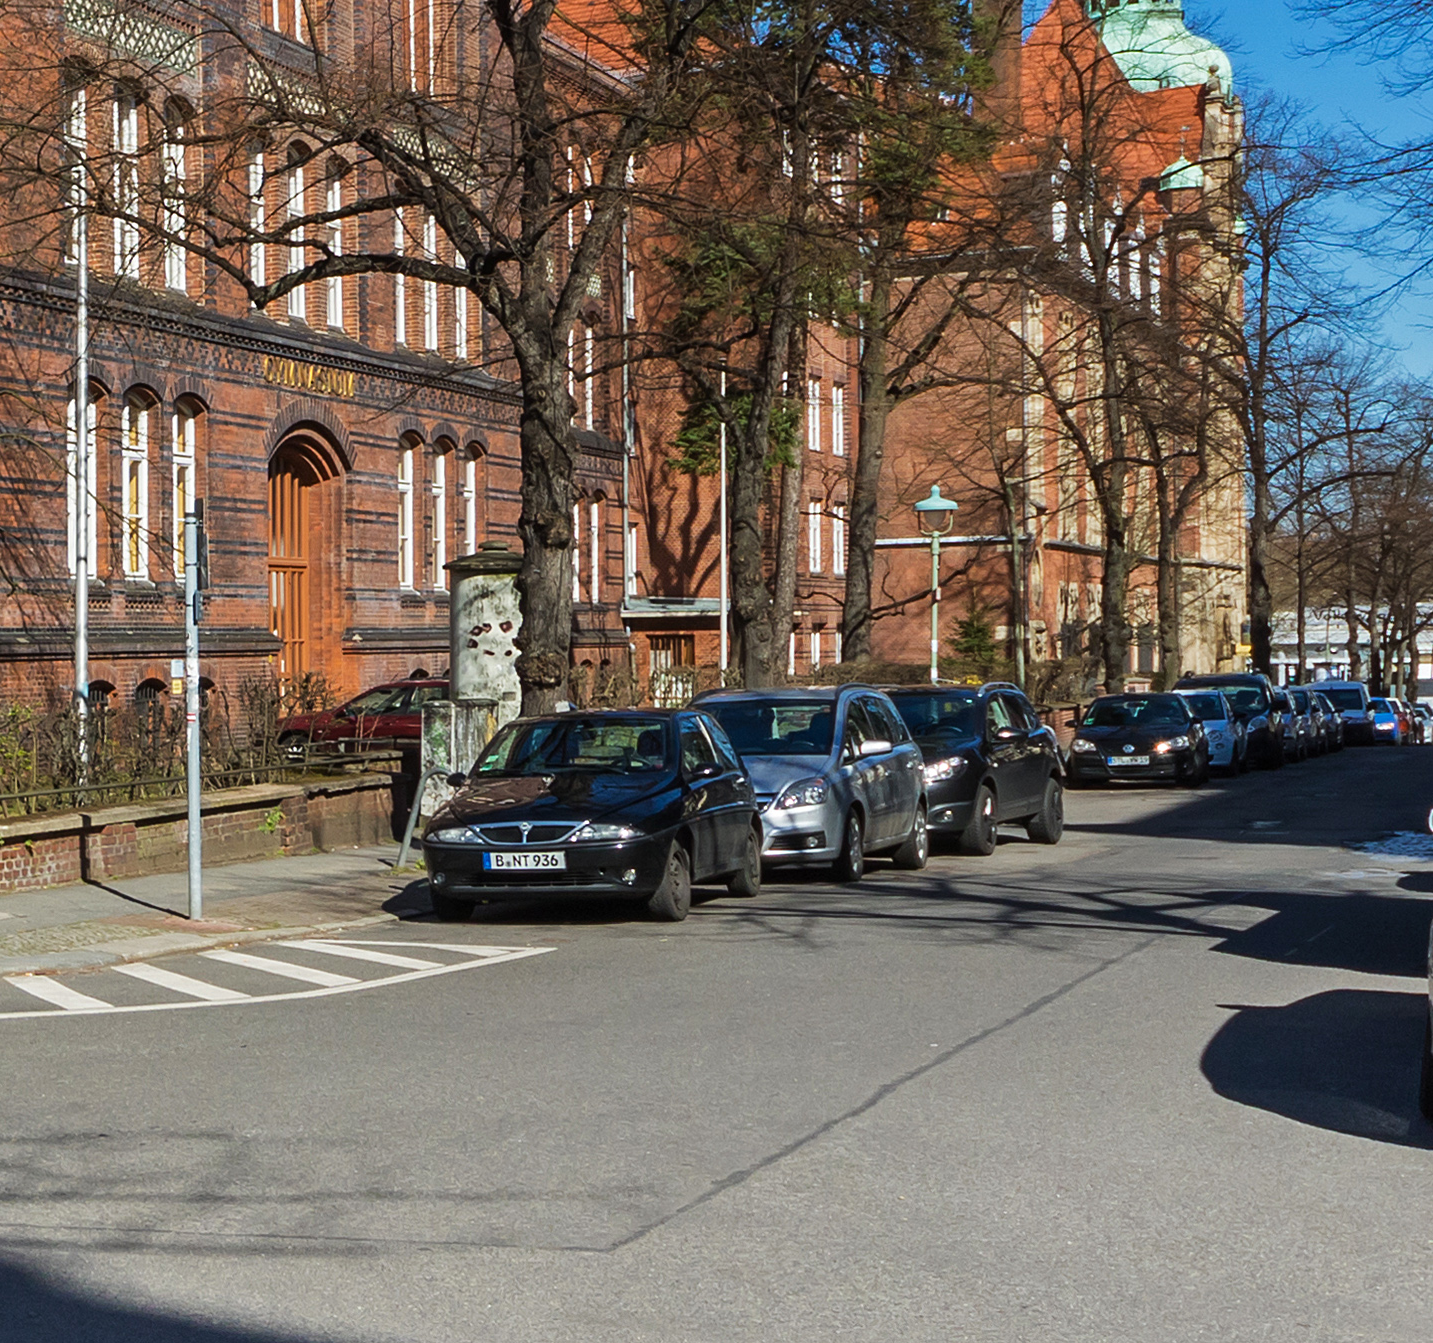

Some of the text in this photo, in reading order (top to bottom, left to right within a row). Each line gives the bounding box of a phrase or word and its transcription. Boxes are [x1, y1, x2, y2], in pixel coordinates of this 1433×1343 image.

[495, 854, 559, 867] B NT 936
